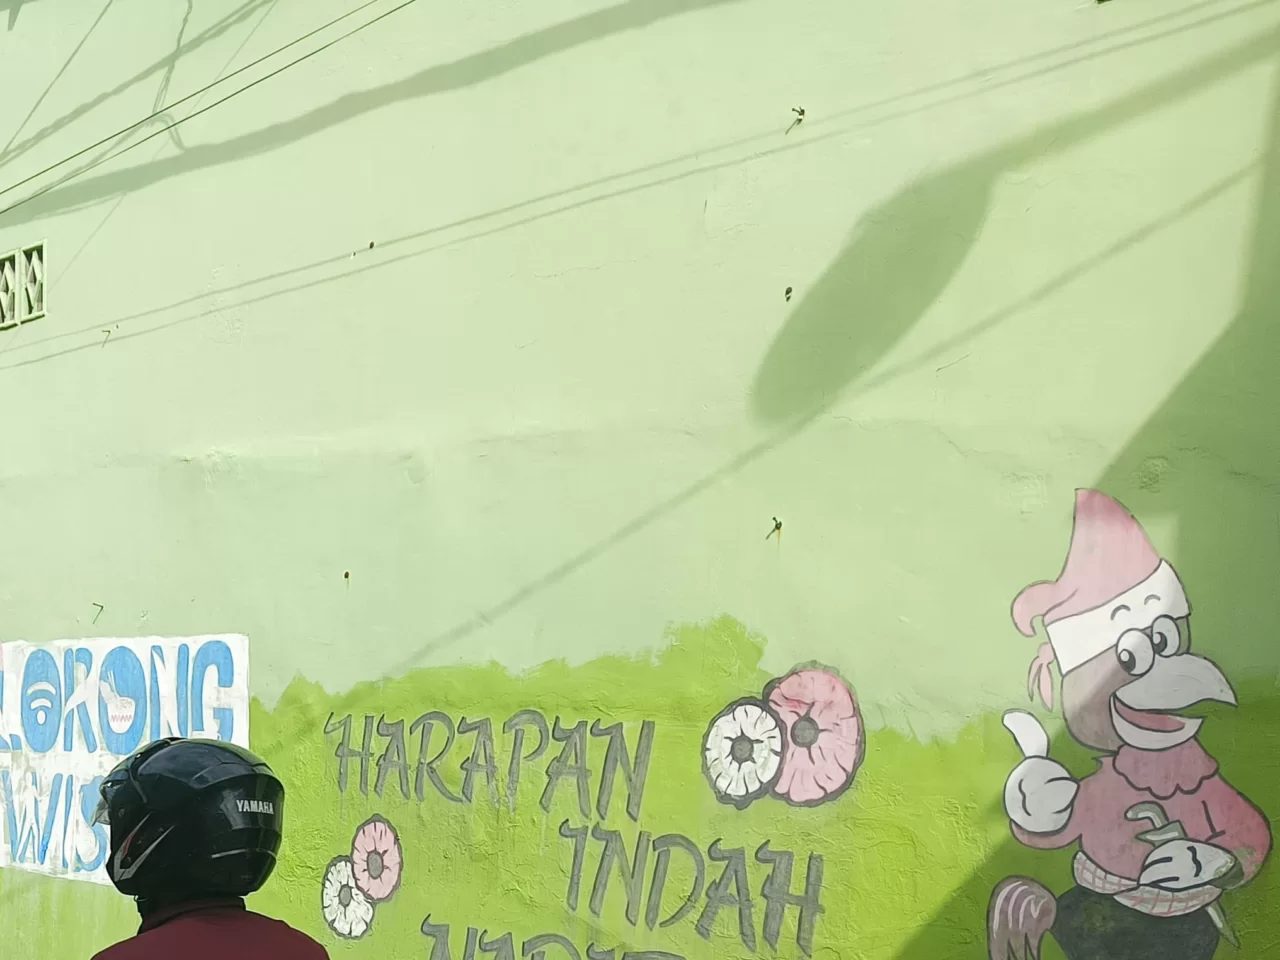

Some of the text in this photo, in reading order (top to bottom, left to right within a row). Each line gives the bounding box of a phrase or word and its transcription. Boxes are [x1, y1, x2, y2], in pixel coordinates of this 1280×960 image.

[236, 799, 274, 815] YAMAHA
[324, 708, 655, 822] HARAPAN
[558, 817, 825, 958] INDAH
